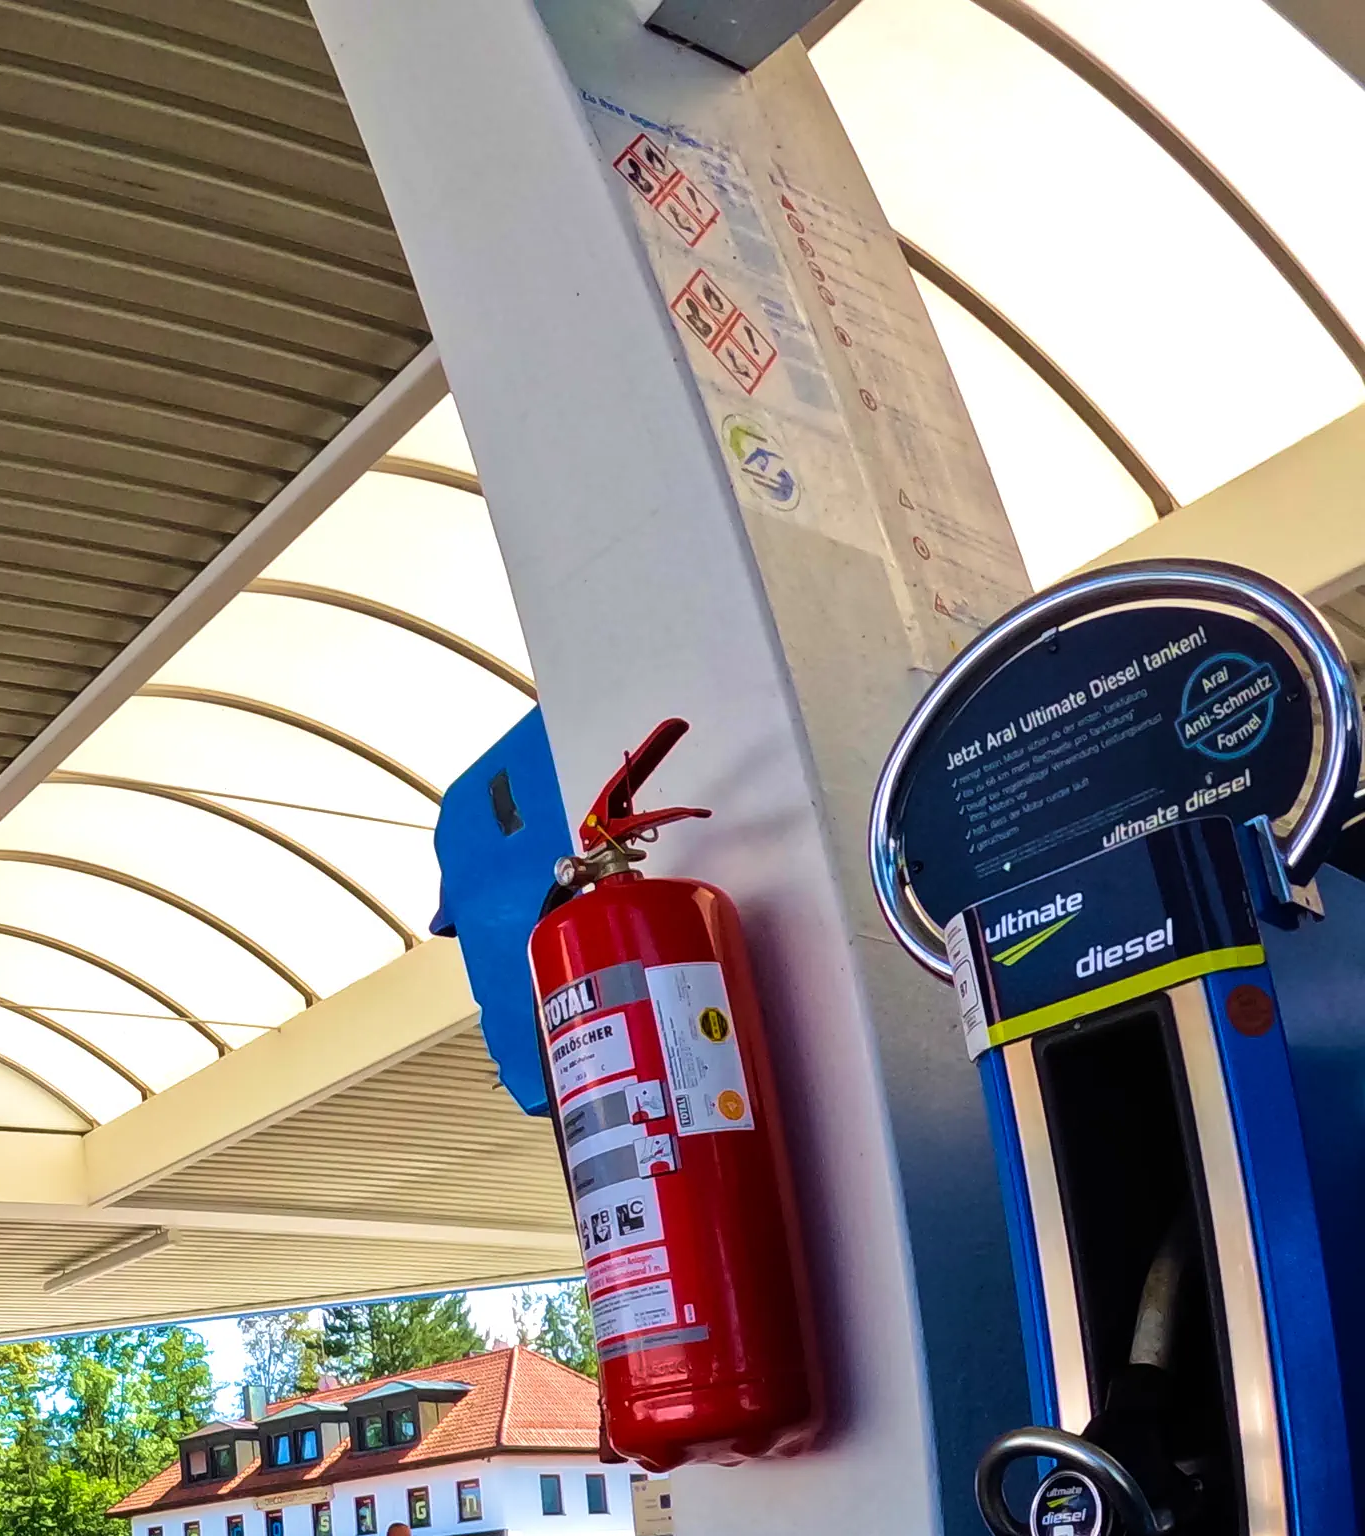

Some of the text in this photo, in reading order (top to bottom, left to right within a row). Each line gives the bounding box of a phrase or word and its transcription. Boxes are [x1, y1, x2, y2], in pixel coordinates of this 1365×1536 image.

[946, 625, 1207, 770] Jetzt Aral Ultimate Diesel tanken!
[1202, 666, 1229, 694] Aral
[1184, 675, 1273, 739] Anti-Schmutz
[1217, 713, 1262, 750] Formel
[1102, 802, 1179, 849] ultimate
[1185, 767, 1251, 813] diesel
[985, 892, 1083, 944] ultimate
[1076, 917, 1174, 979] diesel
[544, 980, 595, 1031] TOTAL
[676, 1095, 692, 1127] TOTAL
[601, 1209, 610, 1224] B
[630, 1200, 644, 1215] C
[1042, 1508, 1087, 1525] diesel
